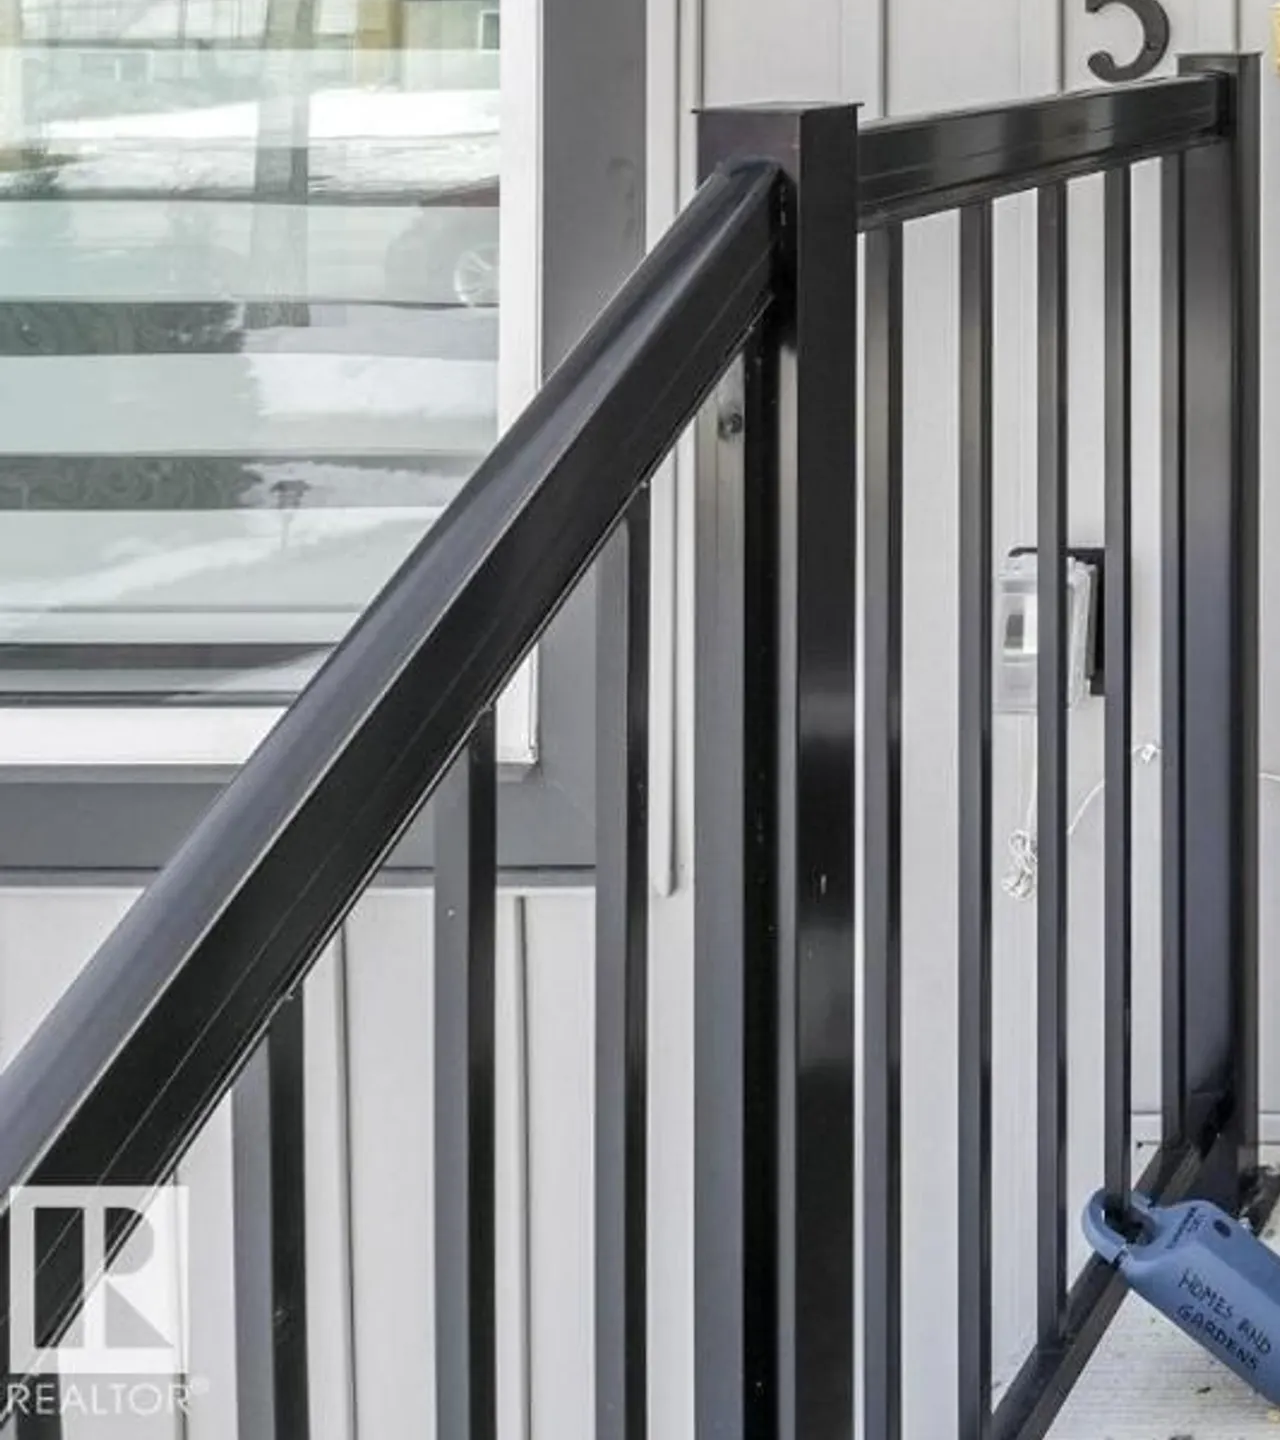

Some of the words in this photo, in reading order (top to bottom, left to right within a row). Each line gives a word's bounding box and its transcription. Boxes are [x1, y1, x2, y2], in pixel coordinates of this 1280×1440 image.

[1177, 1305, 1258, 1370] GARDENS
[1178, 1267, 1233, 1320] HOMES
[1237, 1317, 1271, 1355] AND
